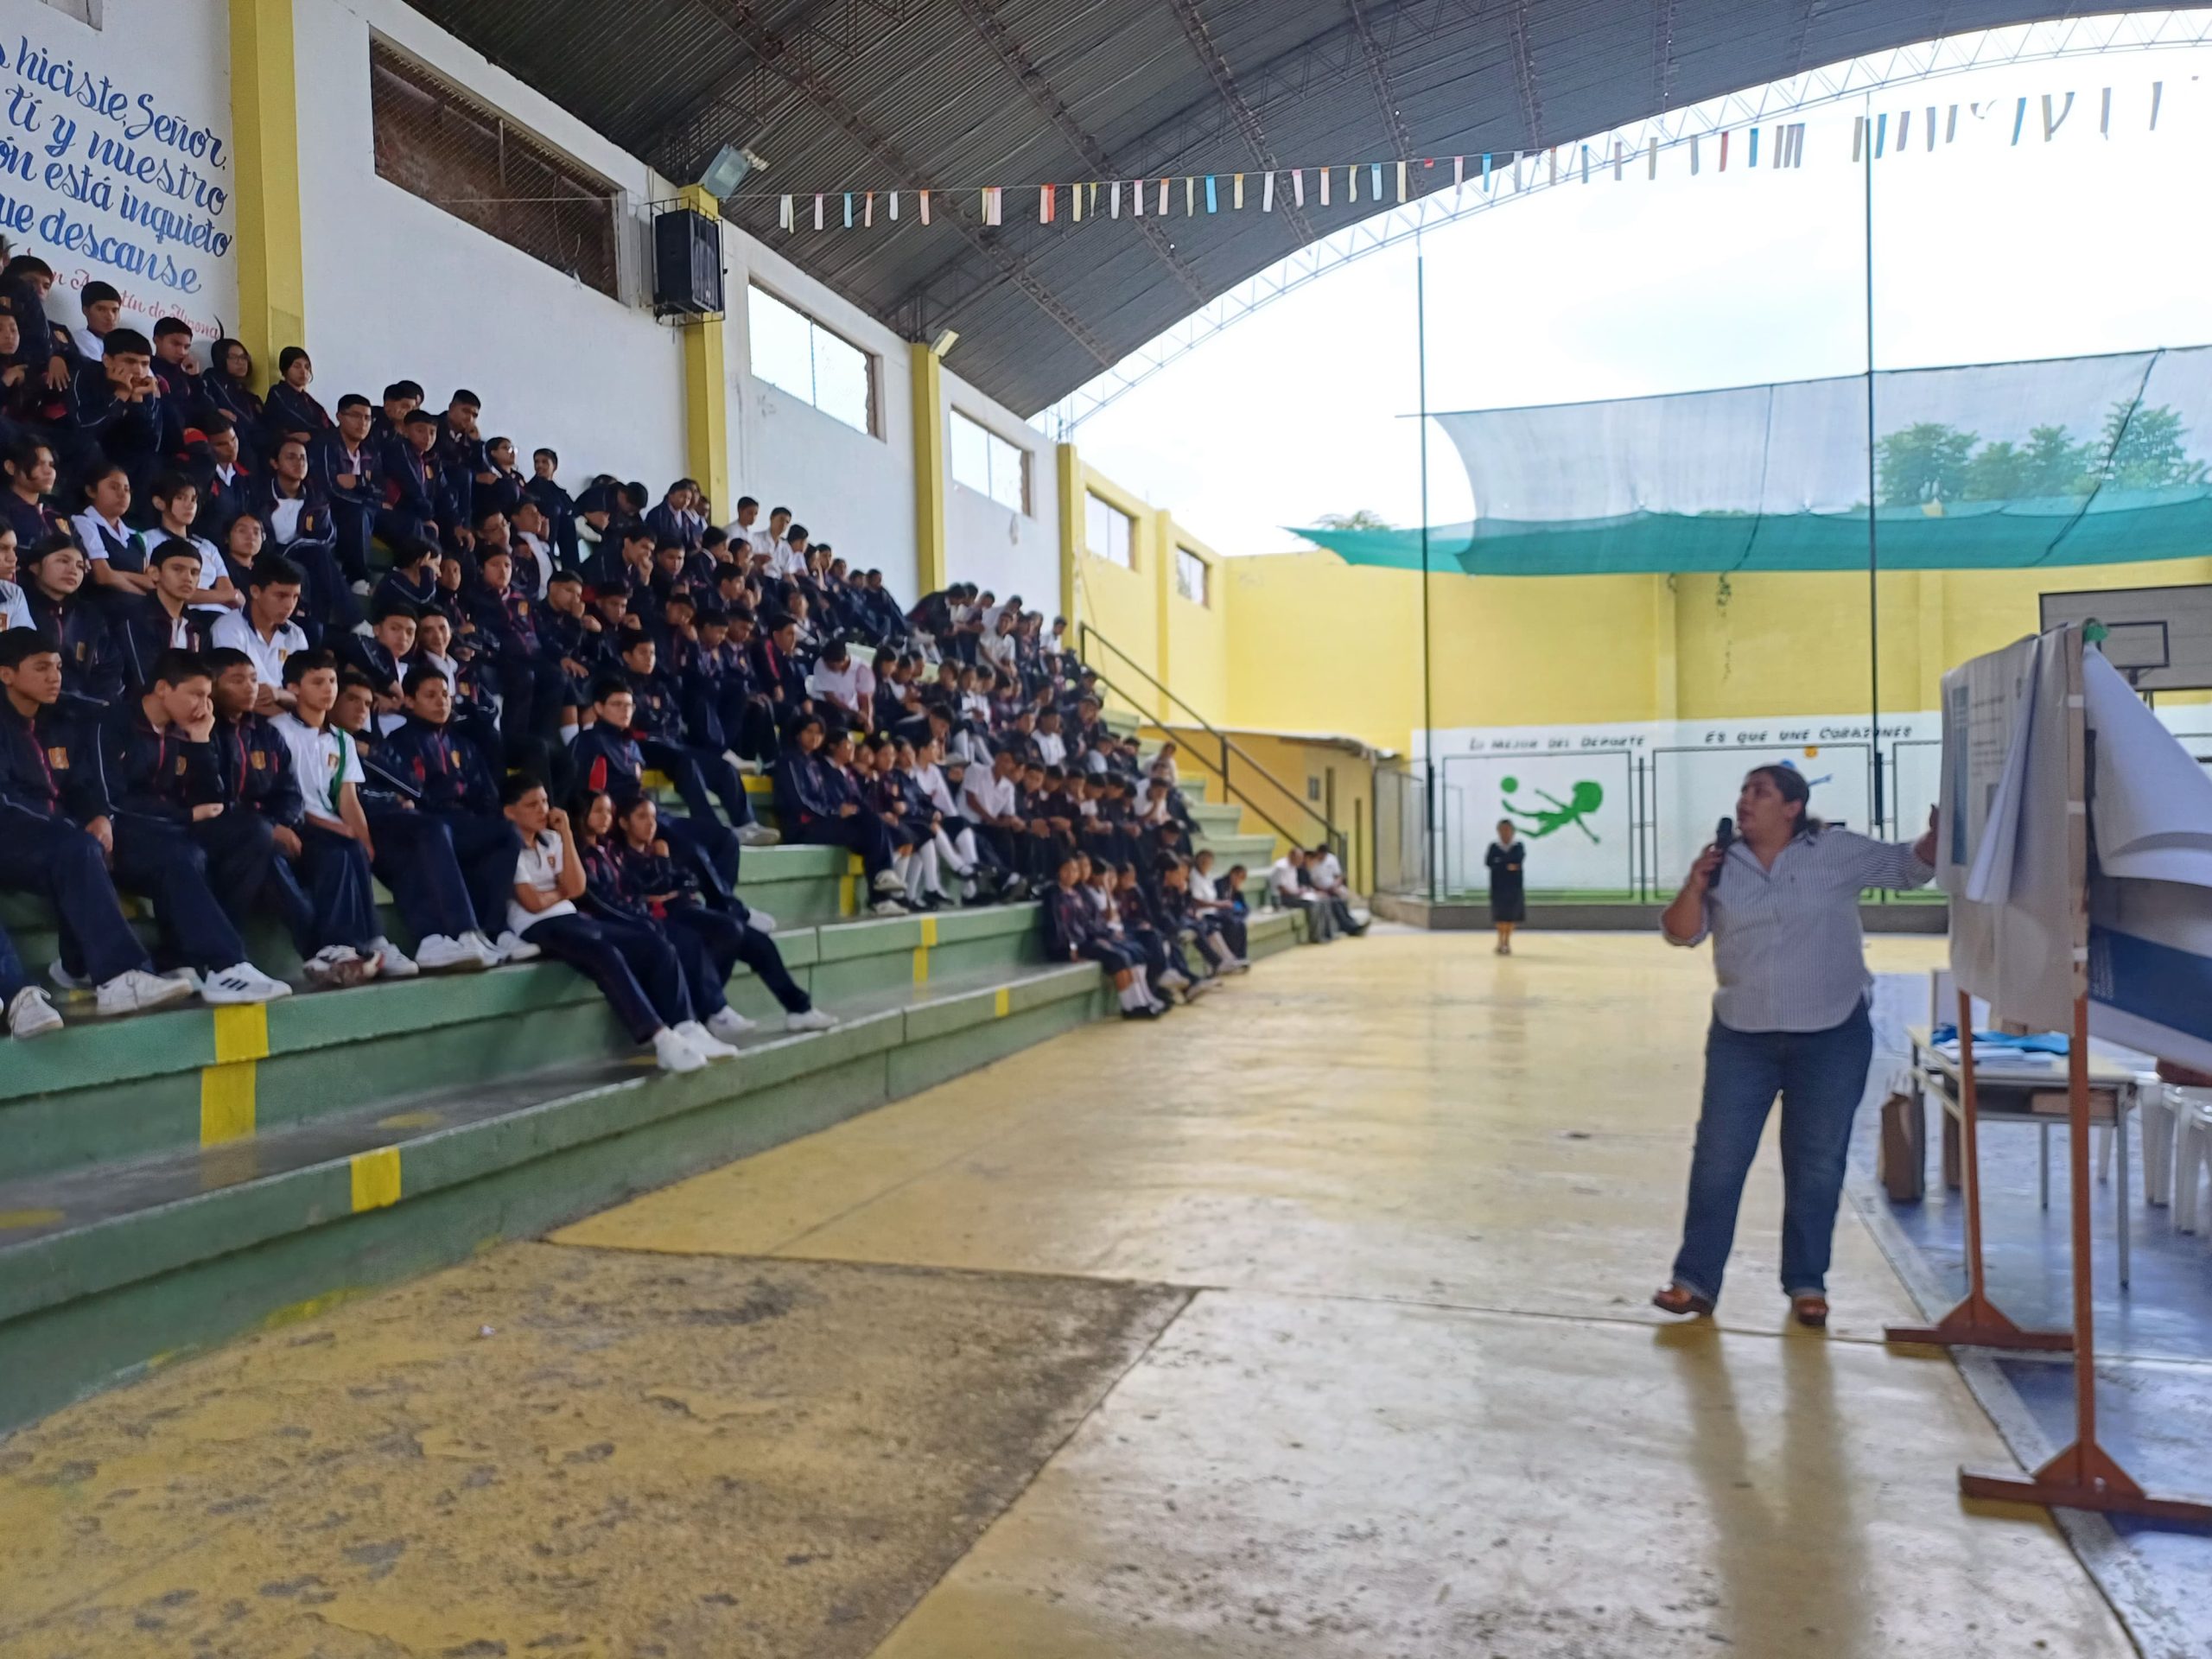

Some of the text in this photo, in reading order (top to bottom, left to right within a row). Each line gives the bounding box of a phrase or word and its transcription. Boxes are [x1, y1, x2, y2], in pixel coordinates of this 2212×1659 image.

[44, 114, 76, 157] y
[88, 130, 227, 216] nuestro
[44, 162, 114, 212] está
[120, 185, 232, 257] inquieto
[40, 207, 201, 294] descanse
[1705, 731, 1726, 743] ES
[1737, 731, 1768, 743] QUE
[1779, 729, 1810, 741] UNE
